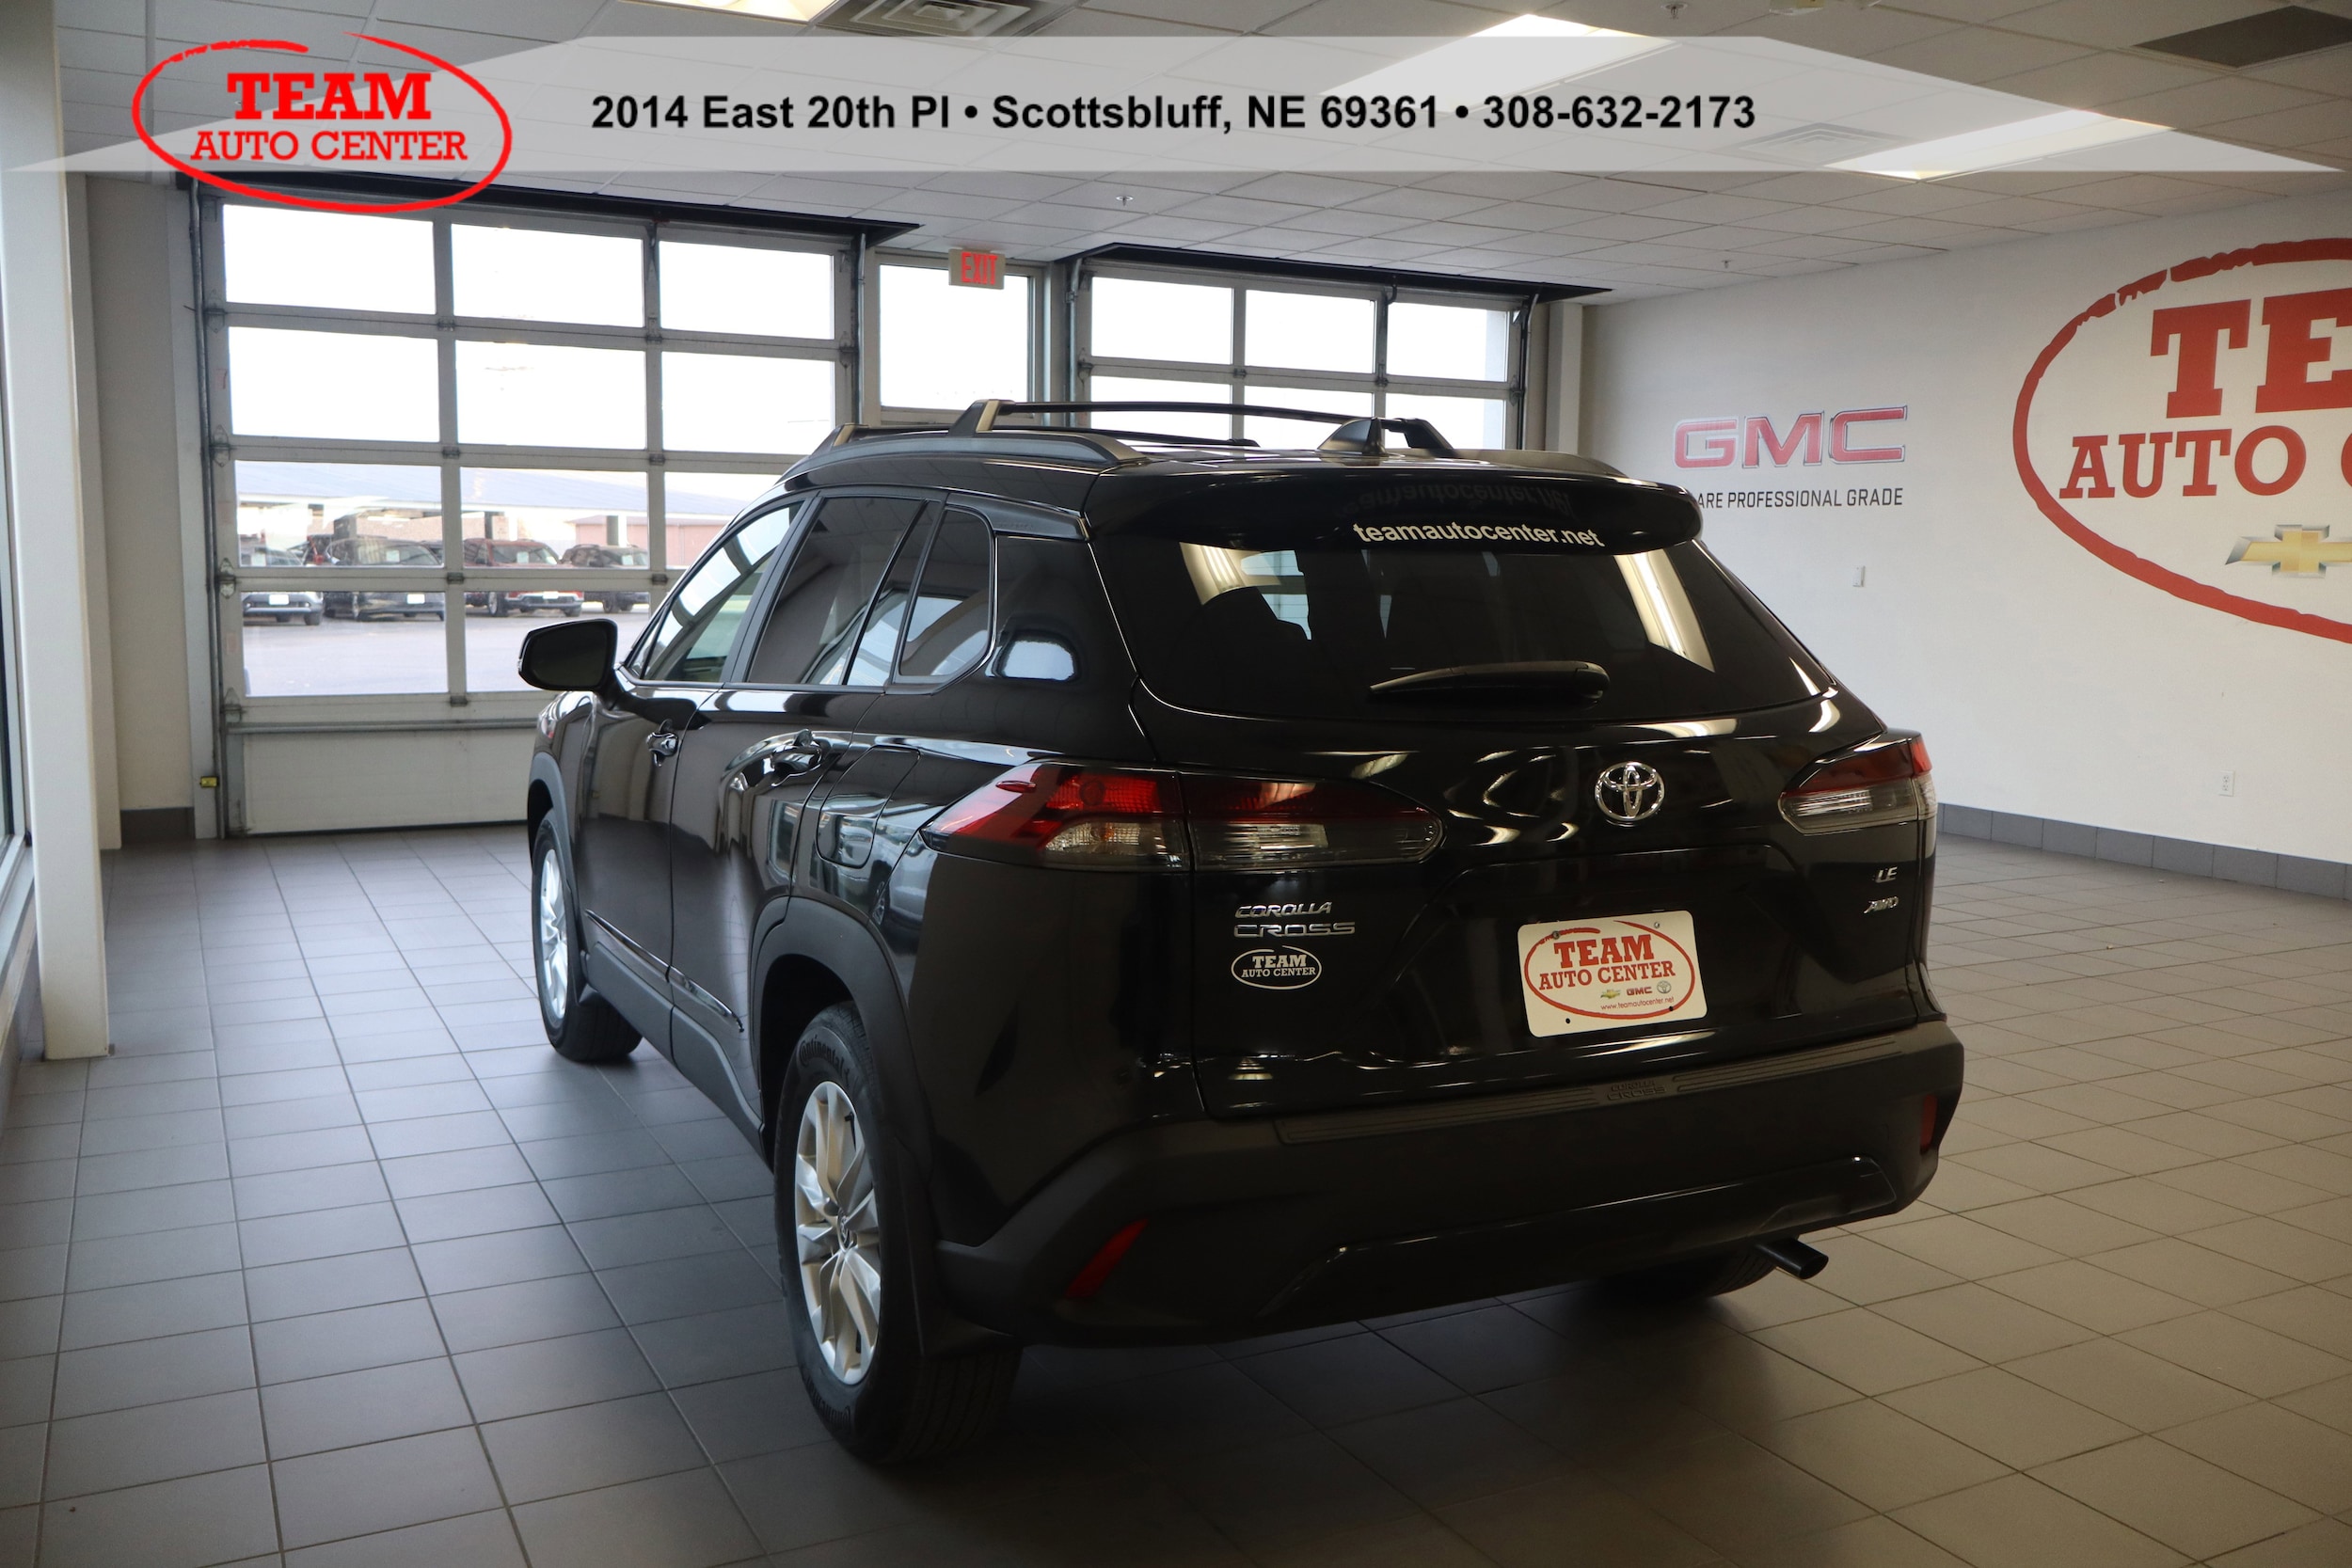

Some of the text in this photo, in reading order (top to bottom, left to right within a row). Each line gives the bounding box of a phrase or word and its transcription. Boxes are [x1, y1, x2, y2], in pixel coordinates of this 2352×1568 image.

[961, 251, 998, 285] EXIT
[1674, 404, 1908, 469] GMC
[2058, 425, 2308, 499] AUTO
[1697, 487, 1903, 509] ARE PROFESSIONAL GRADE
[1353, 520, 1605, 547] teamautocenter.net
[1875, 866, 1898, 883] LE
[1234, 901, 1333, 918] COROLLA
[1233, 922, 1356, 938] CROSS
[1553, 934, 1655, 969] TEAM
[1251, 954, 1308, 969] TEAM
[1241, 966, 1316, 978] AUTO CENTER
[1538, 960, 1676, 990] AUTO CENTER
[1627, 987, 1653, 996] GMC
[1600, 996, 1675, 1010] www.teamautocenter.net
[799, 1034, 845, 1079] Continental
[1607, 1086, 1665, 1101] CROSS
